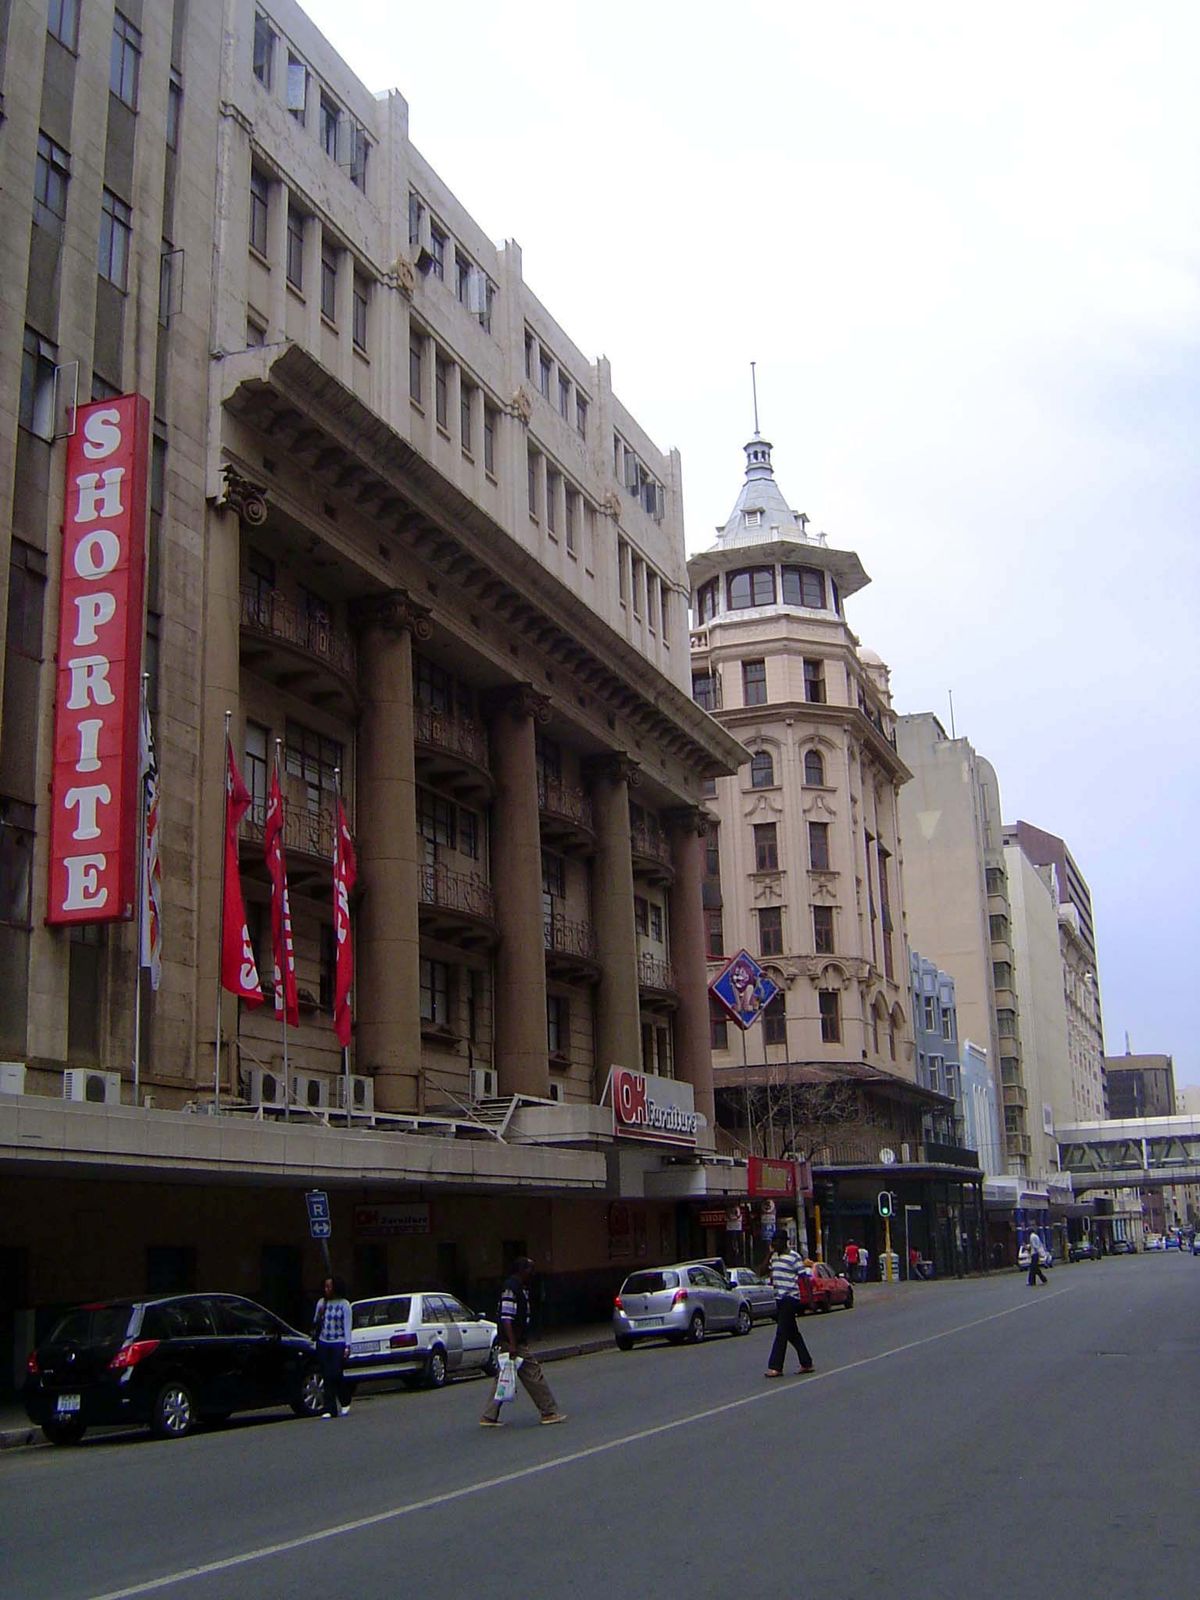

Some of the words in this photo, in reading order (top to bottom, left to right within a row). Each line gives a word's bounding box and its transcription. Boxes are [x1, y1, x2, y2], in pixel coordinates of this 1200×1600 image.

[61, 408, 126, 911] SHOPRITE
[615, 1071, 648, 1124] OK
[647, 1098, 697, 1133] Furniture
[313, 1203, 324, 1216] R
